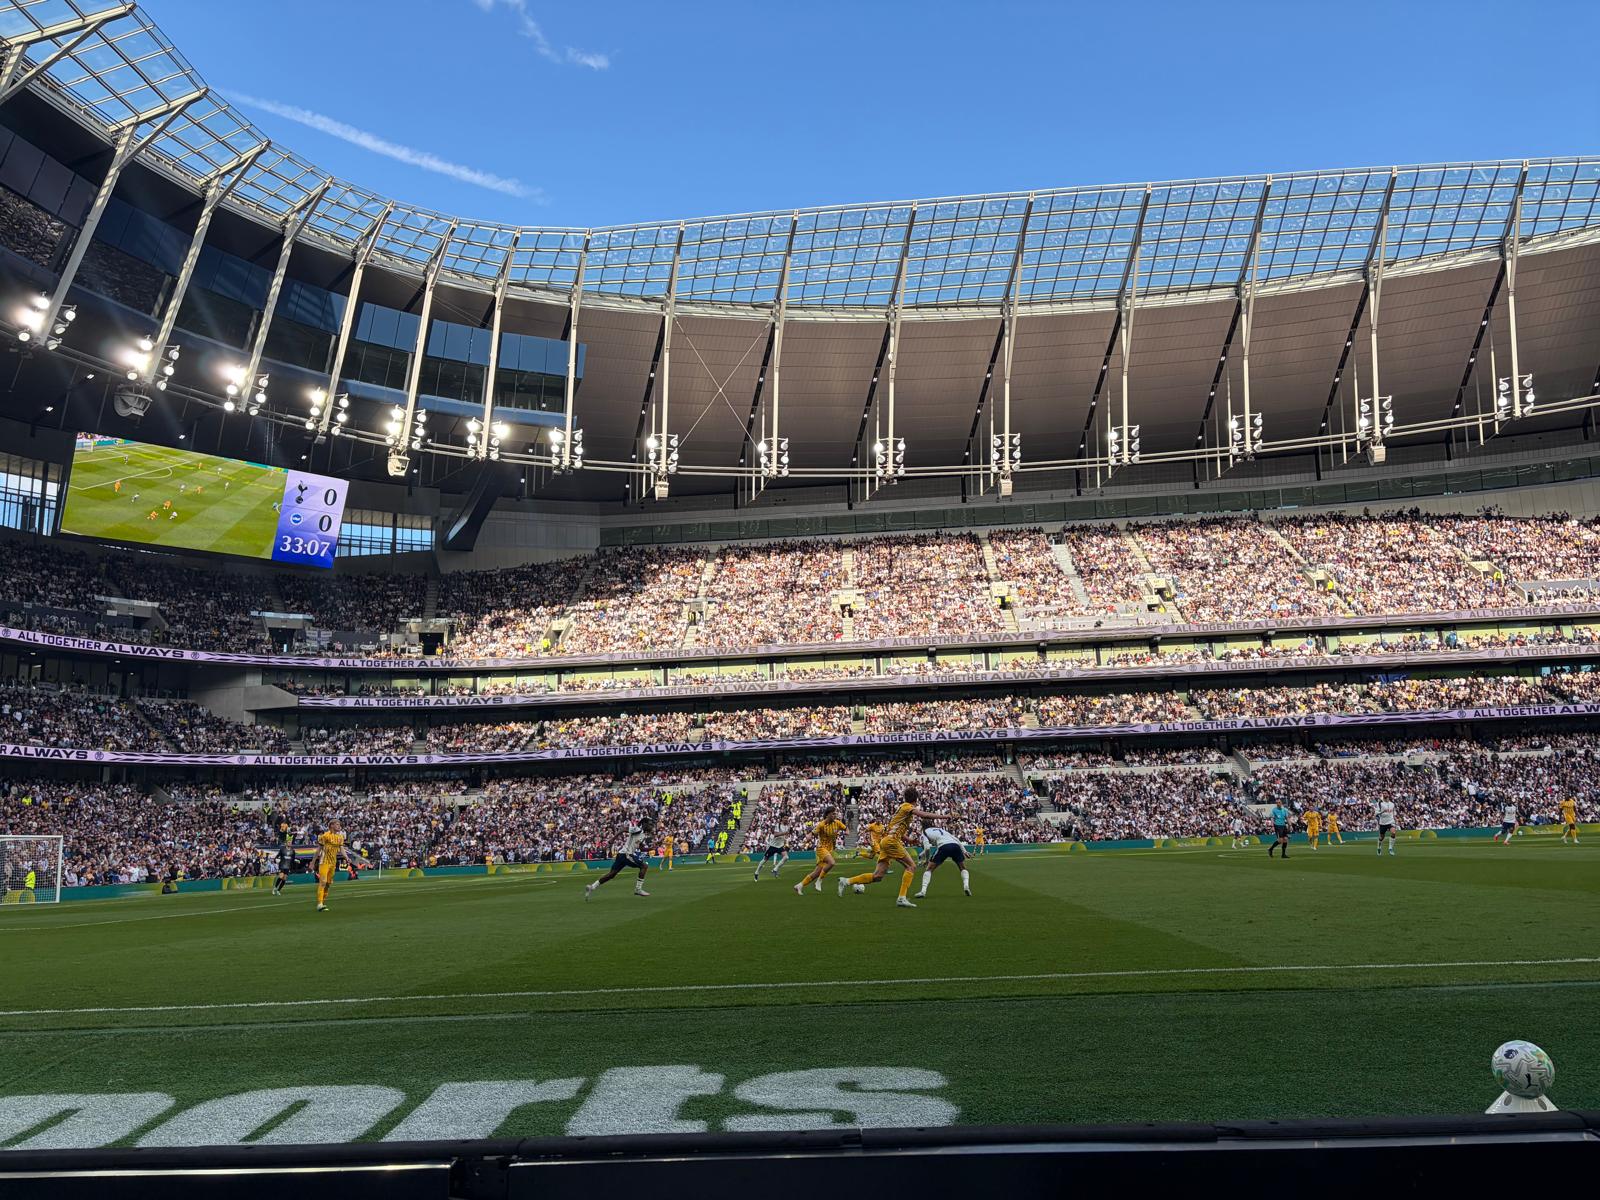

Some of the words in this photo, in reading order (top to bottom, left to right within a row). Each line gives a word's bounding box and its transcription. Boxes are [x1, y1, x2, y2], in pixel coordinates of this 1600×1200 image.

[324, 488, 338, 506] 0
[318, 514, 333, 532] 0
[280, 535, 331, 557] 33:07
[1490, 608, 1546, 617] TOGETHER
[1192, 623, 1249, 631] TOGETHER
[1254, 619, 1322, 628] ALWAYS
[18, 631, 39, 642] ALL
[41, 634, 101, 650] TOGETHER
[104, 644, 184, 658] ALWAYS
[892, 638, 910, 646] ALL
[911, 635, 963, 645] TOGETHER
[967, 632, 1034, 642] ALWAYS
[641, 650, 690, 659] TOGETHER
[693, 646, 758, 656] ALWAYS
[1526, 646, 1580, 656] TOGETHER
[418, 659, 487, 668] ALWAYS
[1224, 661, 1278, 670] TOGETHER
[1282, 657, 1353, 666] ALWAYS
[934, 674, 987, 682] TOGETHER
[990, 671, 1060, 680] ALWAYS
[660, 686, 709, 696] TOGETHER
[712, 684, 778, 693] ALWAYS
[433, 697, 503, 705] ALWAYS
[1496, 707, 1556, 717] TOGETHER
[1158, 724, 1179, 732] ALL
[1180, 720, 1238, 731] TOGETHER
[1240, 717, 1316, 728] ALWAYS
[877, 732, 932, 742] TOGETHER
[935, 730, 1007, 740] ALWAYS
[10, 746, 88, 760] ALWAYS
[586, 746, 639, 756] TOGETHER
[642, 743, 712, 753] ALWAYS
[341, 756, 418, 764] ALWAYS
